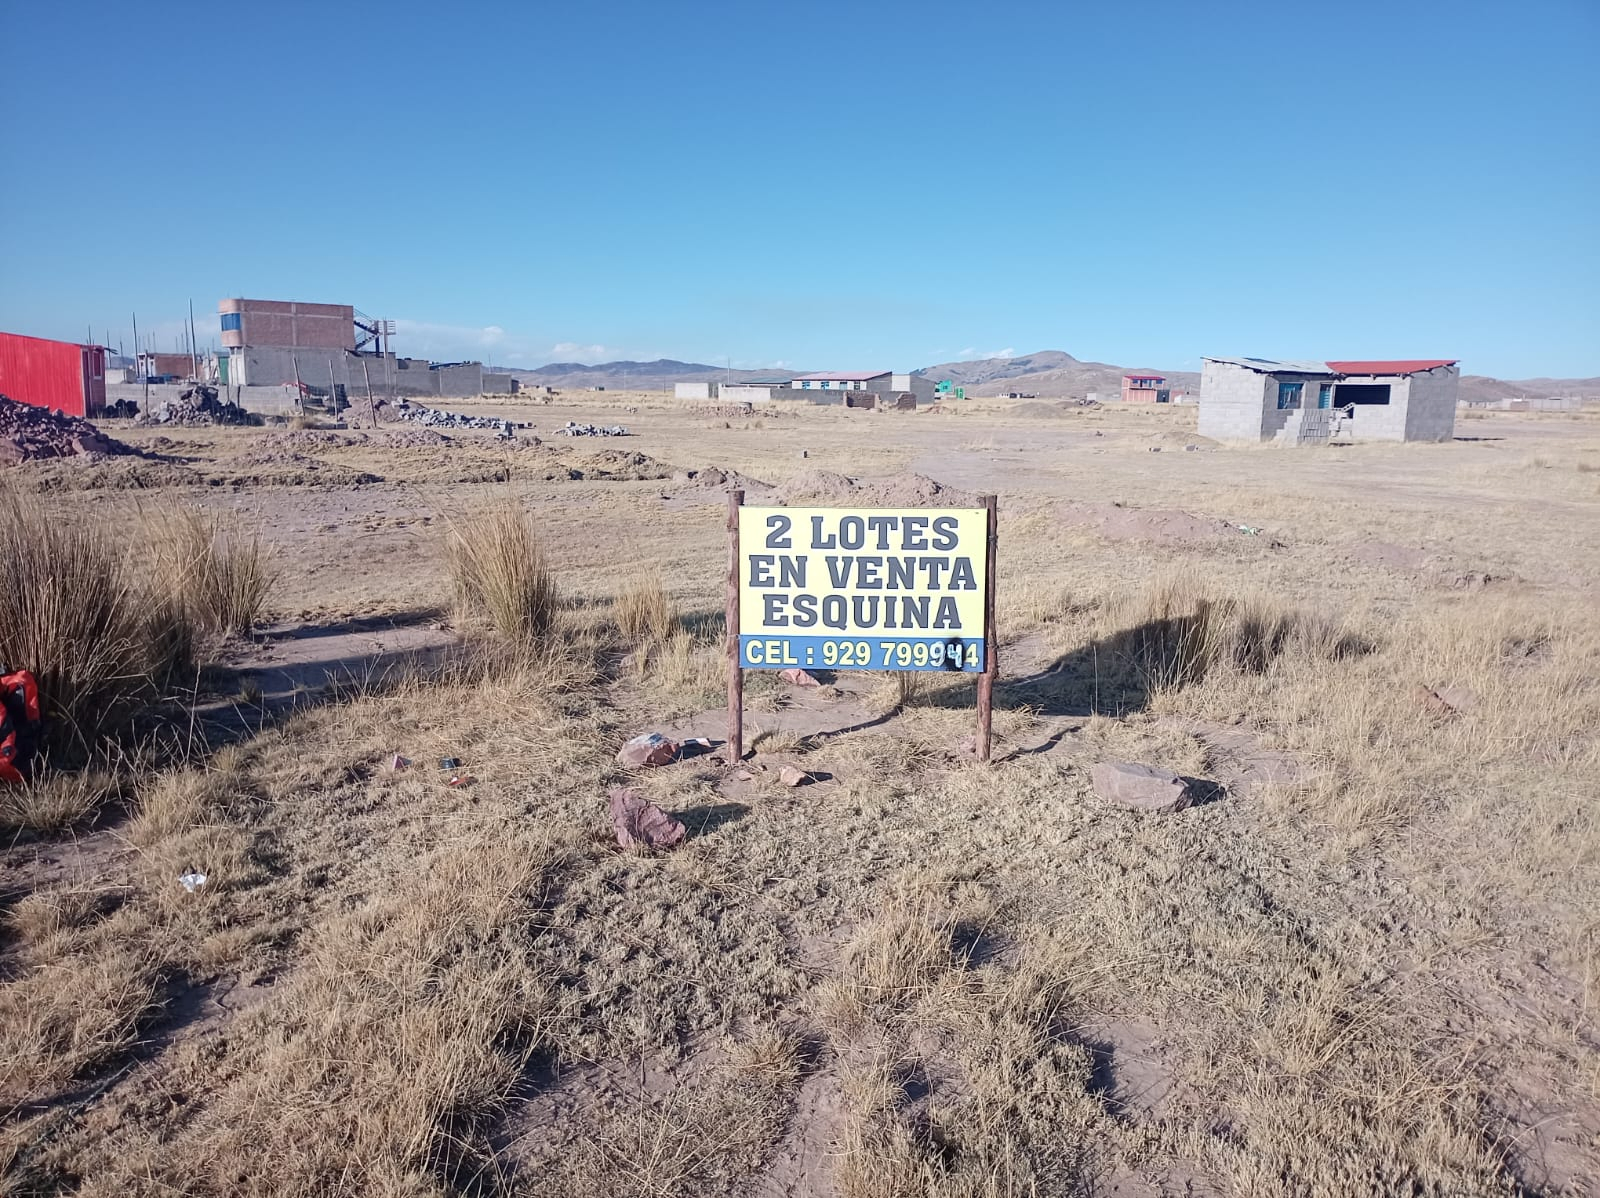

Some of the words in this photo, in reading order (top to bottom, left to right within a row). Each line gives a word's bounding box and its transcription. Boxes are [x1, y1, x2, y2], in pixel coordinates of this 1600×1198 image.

[766, 515, 792, 549] 2
[810, 516, 959, 551] LOTES
[749, 554, 808, 588] EN
[825, 556, 977, 590] VENTA
[762, 594, 962, 630] ESQUINA
[822, 641, 871, 666] 929
